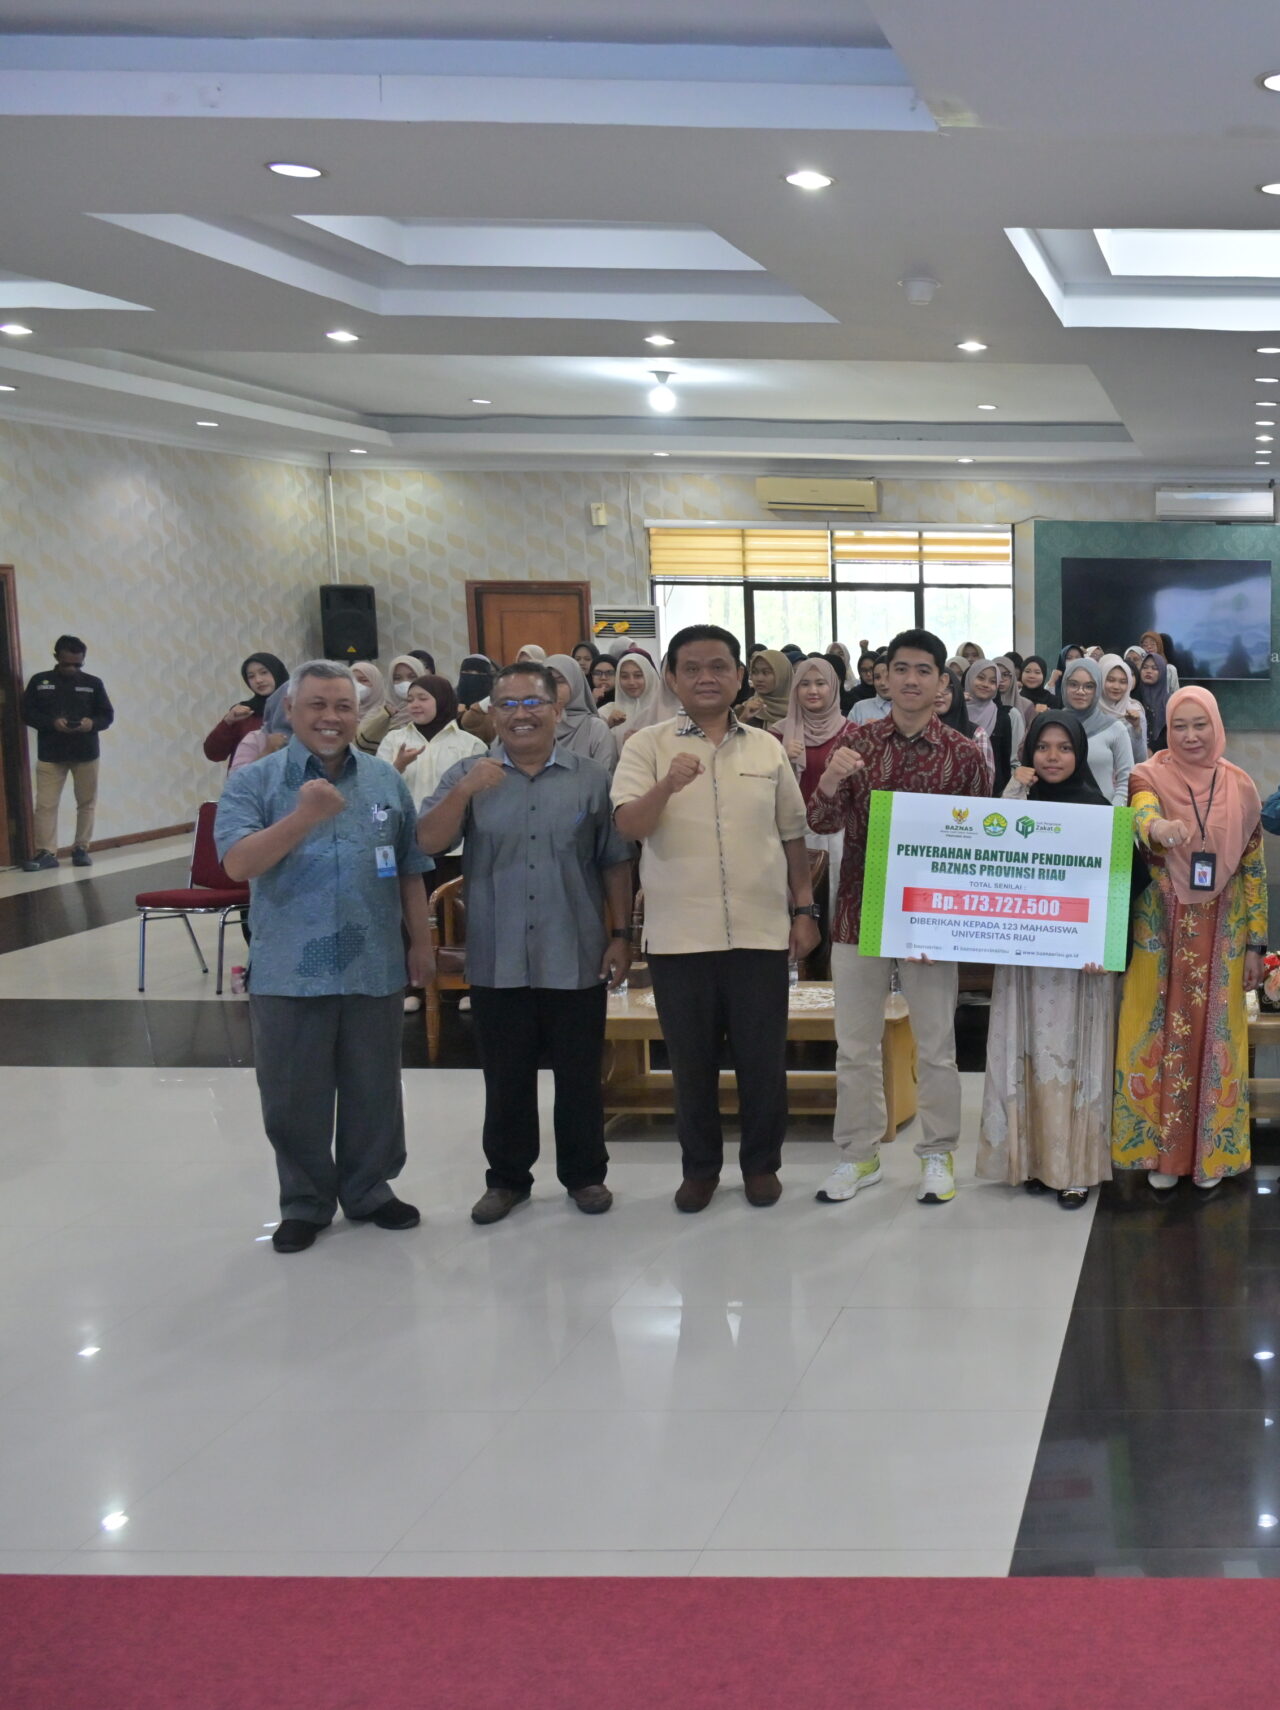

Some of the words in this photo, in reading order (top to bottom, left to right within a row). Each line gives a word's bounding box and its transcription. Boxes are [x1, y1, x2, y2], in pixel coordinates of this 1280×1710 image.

[897, 844, 972, 860] PENYERAHAN
[975, 849, 1029, 864] BANTUAN
[1032, 852, 1102, 868] PENDIDIKAN
[931, 861, 976, 876] BAZNAS
[979, 864, 1035, 880] PROVINSI
[1038, 867, 1066, 881] RIAU
[969, 881, 992, 889] TOTAL
[932, 892, 958, 910] Rp.
[963, 894, 1061, 916] 173.727.500
[910, 917, 961, 927] DIBERIKAN
[963, 920, 1000, 930] KEPADA
[1002, 923, 1018, 931] 123
[1020, 924, 1078, 934] MAHASISWA
[951, 930, 1011, 940] UNIVERSITAS
[1013, 933, 1036, 942] RIAU
